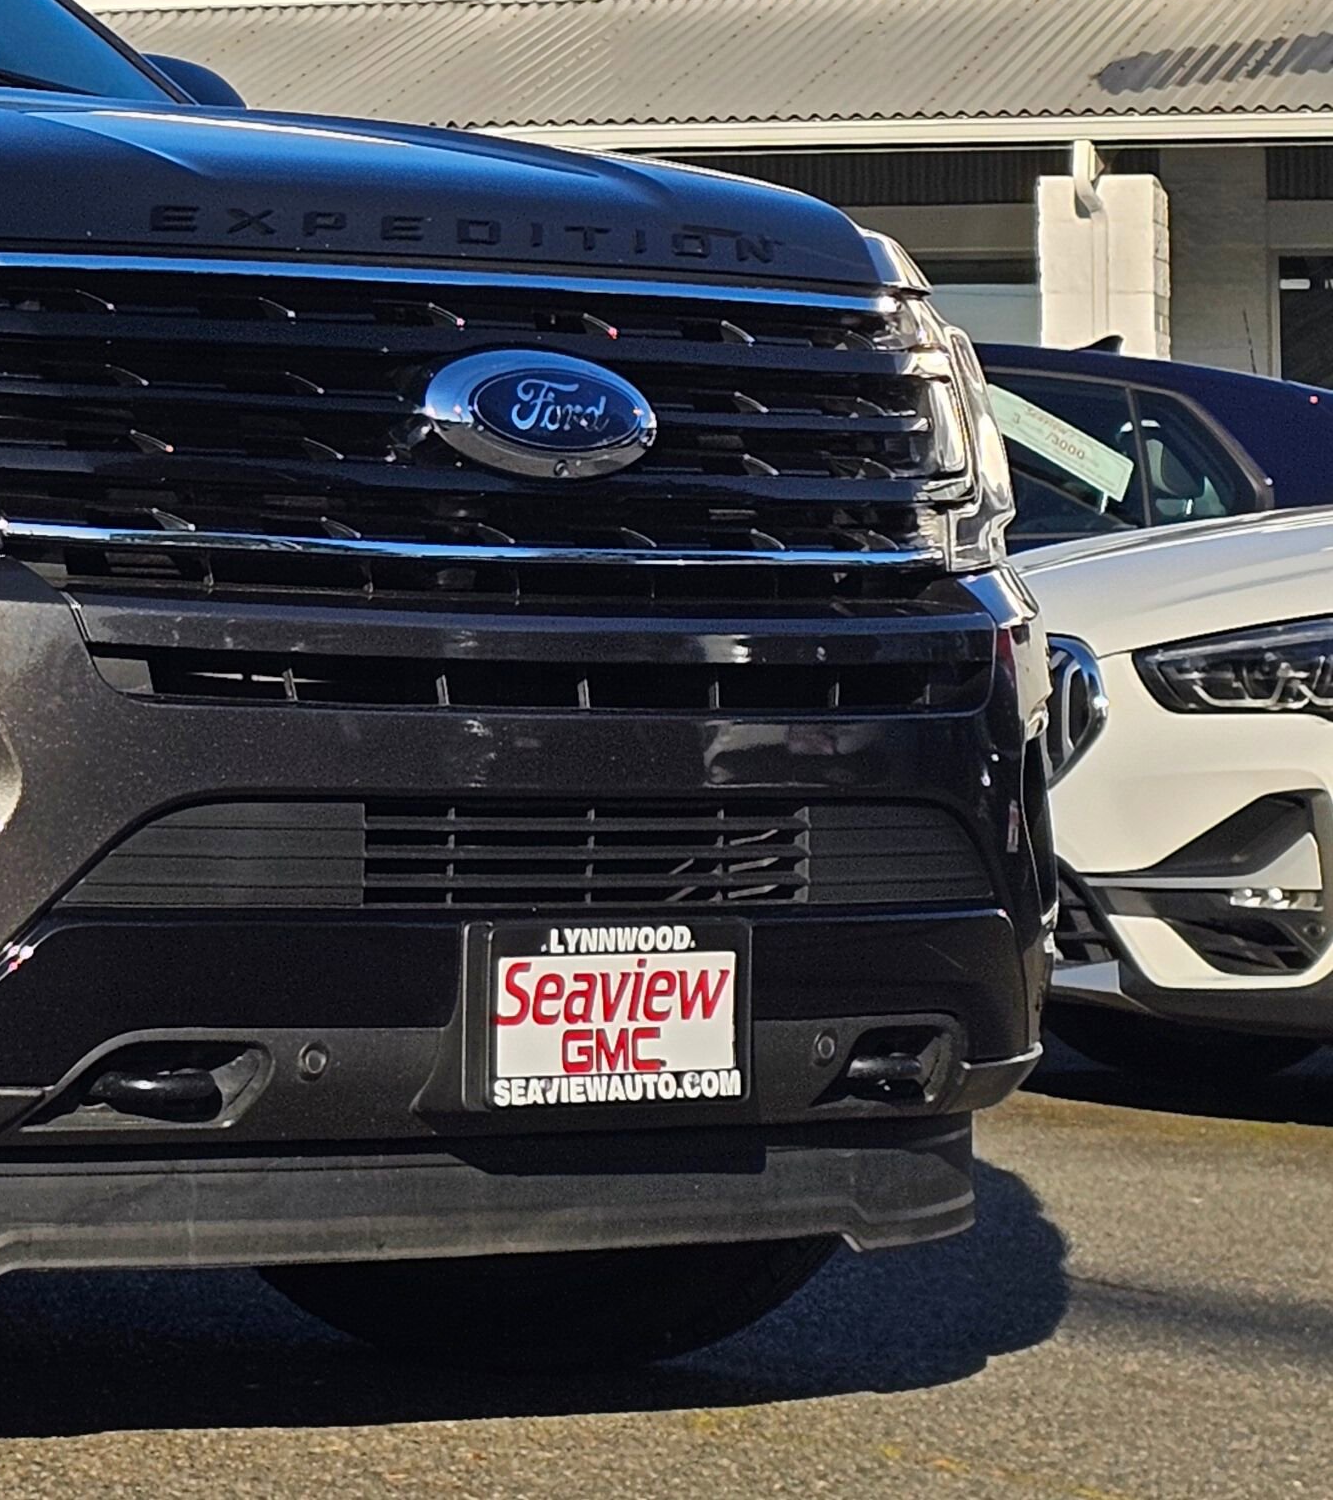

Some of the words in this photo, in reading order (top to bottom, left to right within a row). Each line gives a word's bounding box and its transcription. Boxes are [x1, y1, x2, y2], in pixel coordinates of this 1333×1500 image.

[148, 202, 781, 265] EXPEDITION
[511, 377, 608, 434] Ford
[549, 925, 690, 954] LYNNWOOD
[494, 959, 730, 1025] Seaview
[562, 1028, 664, 1073] GMC
[494, 1071, 741, 1106] SEAVIEWAUTO.COM
